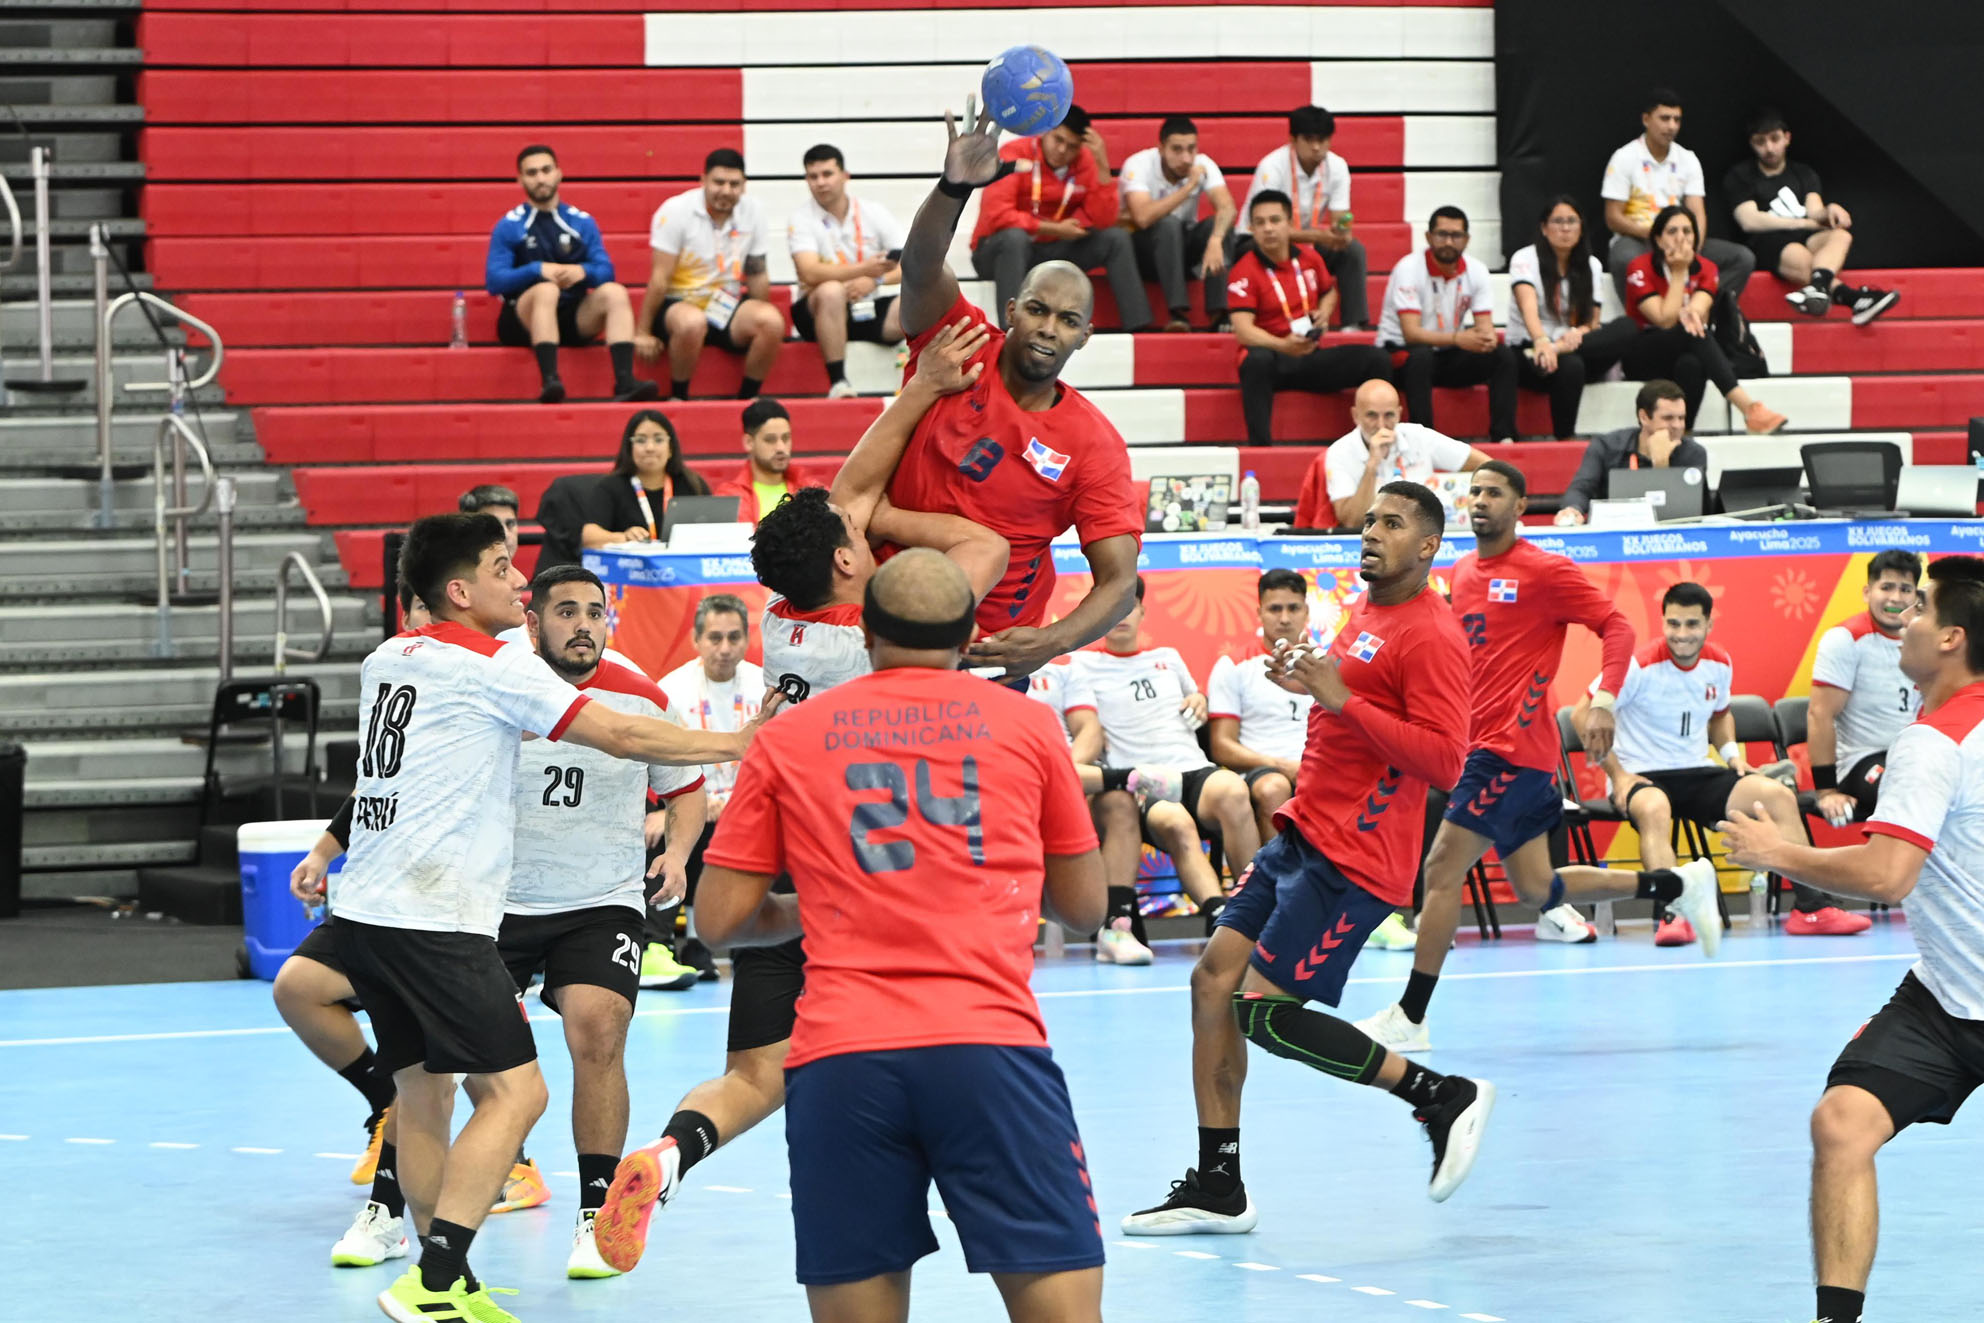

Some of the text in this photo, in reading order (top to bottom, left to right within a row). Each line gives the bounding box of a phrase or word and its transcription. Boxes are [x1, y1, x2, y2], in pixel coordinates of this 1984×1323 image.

[1641, 534, 1683, 544] JUEGOS
[1730, 528, 1788, 542] Ayacucho
[1848, 535, 1930, 546] BOLIVARIANOS
[1865, 526, 1908, 536] JUEGOS
[1281, 543, 1342, 556] Ayacucho
[1623, 541, 1707, 555] BOLIVARIANOS
[1130, 679, 1157, 701] 28
[362, 682, 416, 779] 18
[1680, 711, 1691, 737] 11
[825, 723, 992, 751] DOMINICANA
[542, 766, 585, 807] 29
[845, 754, 986, 874] 24
[612, 932, 640, 975] 29
